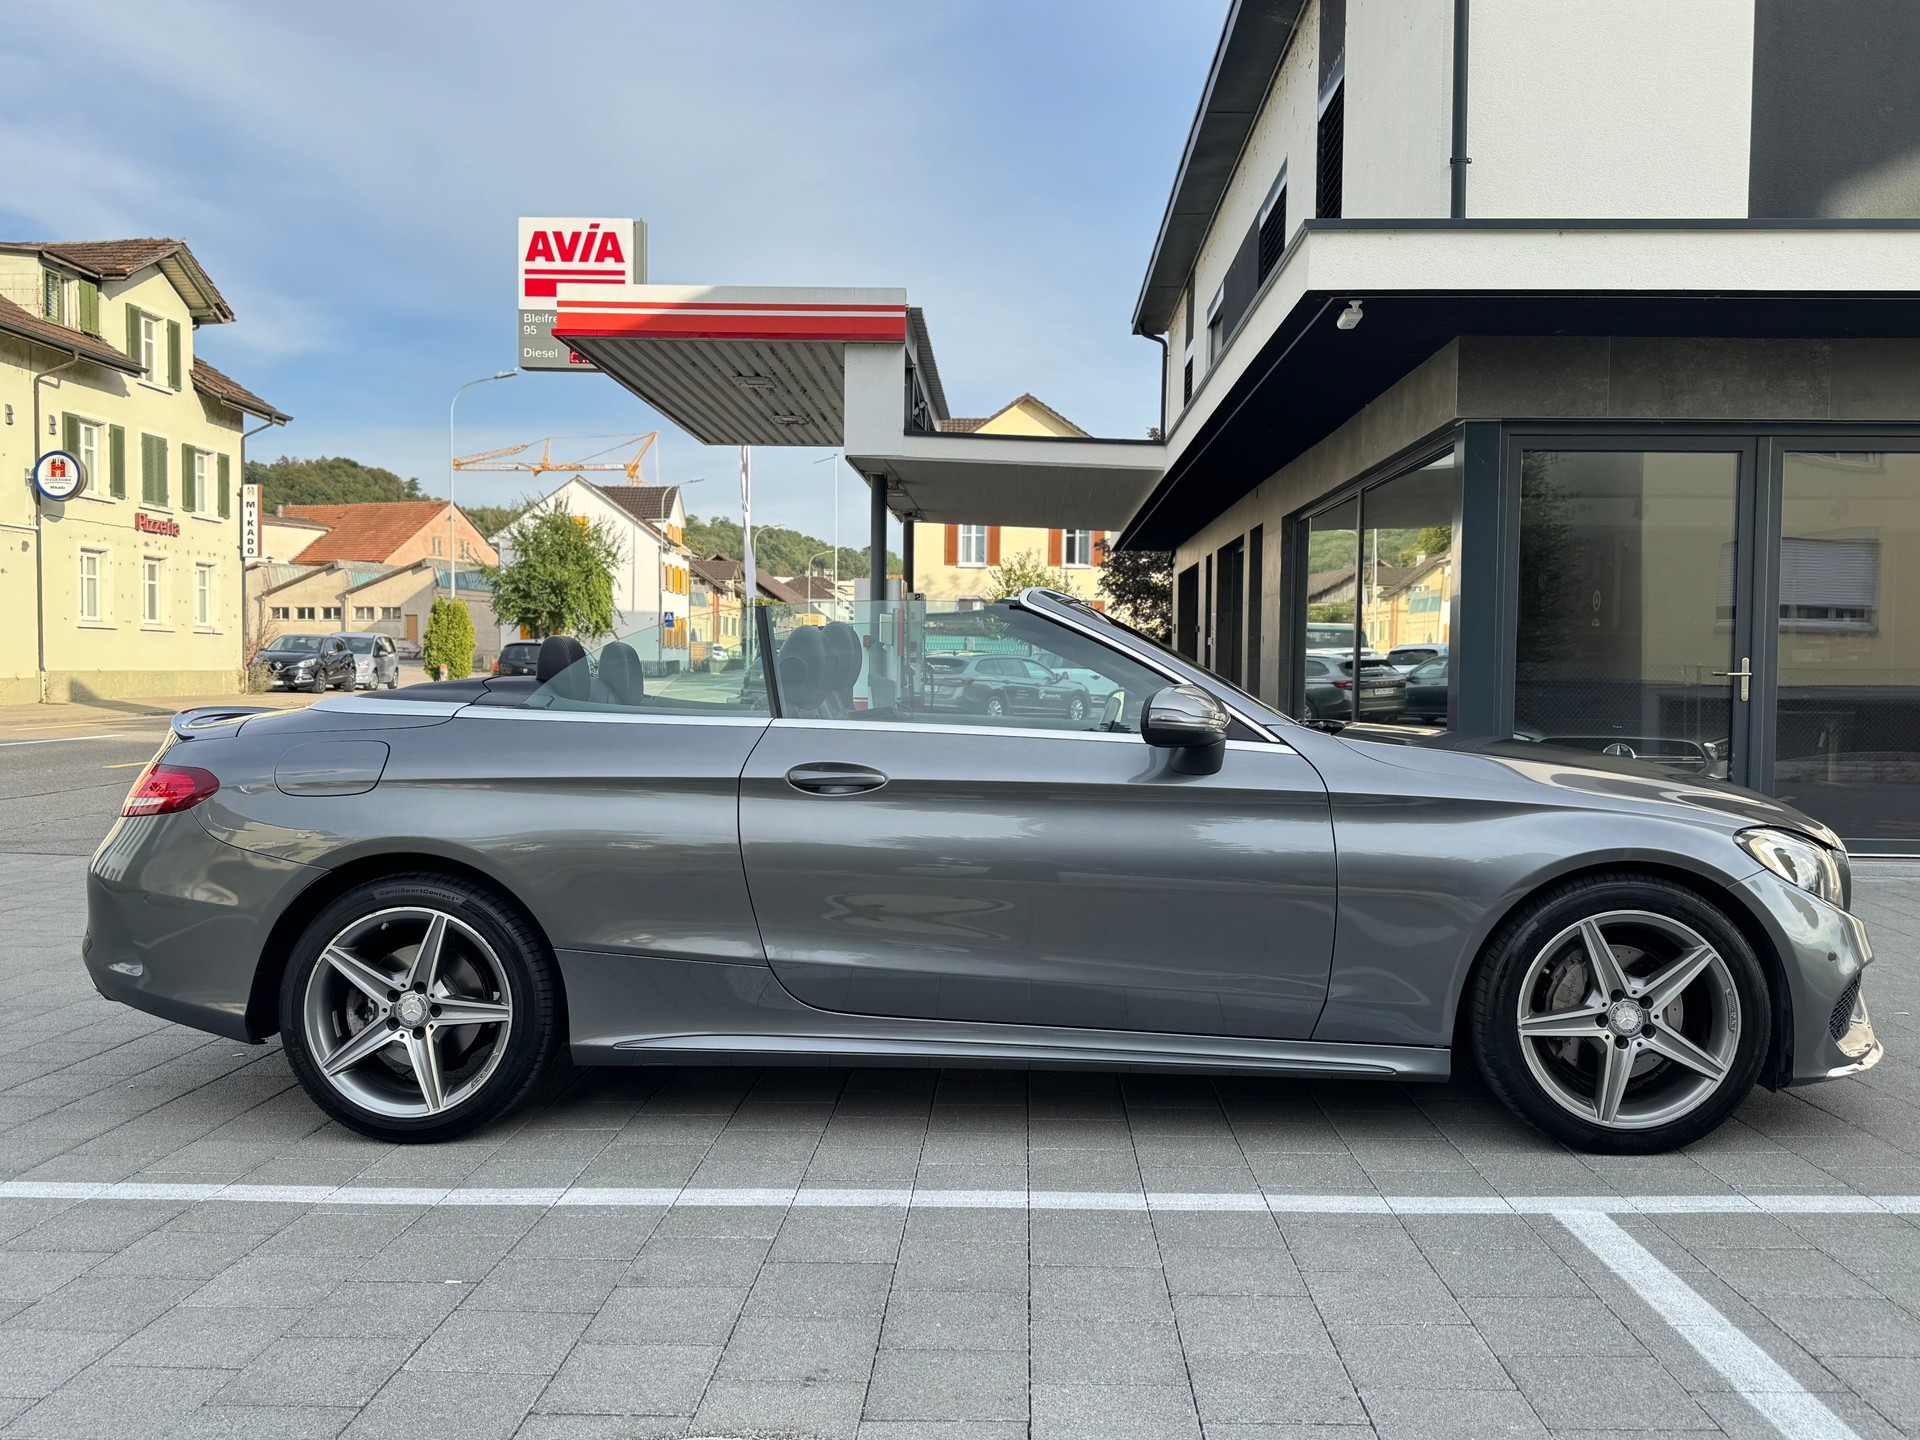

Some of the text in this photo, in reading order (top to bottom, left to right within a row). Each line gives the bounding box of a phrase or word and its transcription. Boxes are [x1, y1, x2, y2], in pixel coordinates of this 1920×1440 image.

[525, 223, 625, 263] AVIA
[524, 325, 537, 335] 95
[524, 348, 558, 358] Diesel
[136, 512, 180, 536] Pizzeria
[246, 501, 255, 554] MIKADO
[914, 593, 921, 601] 2
